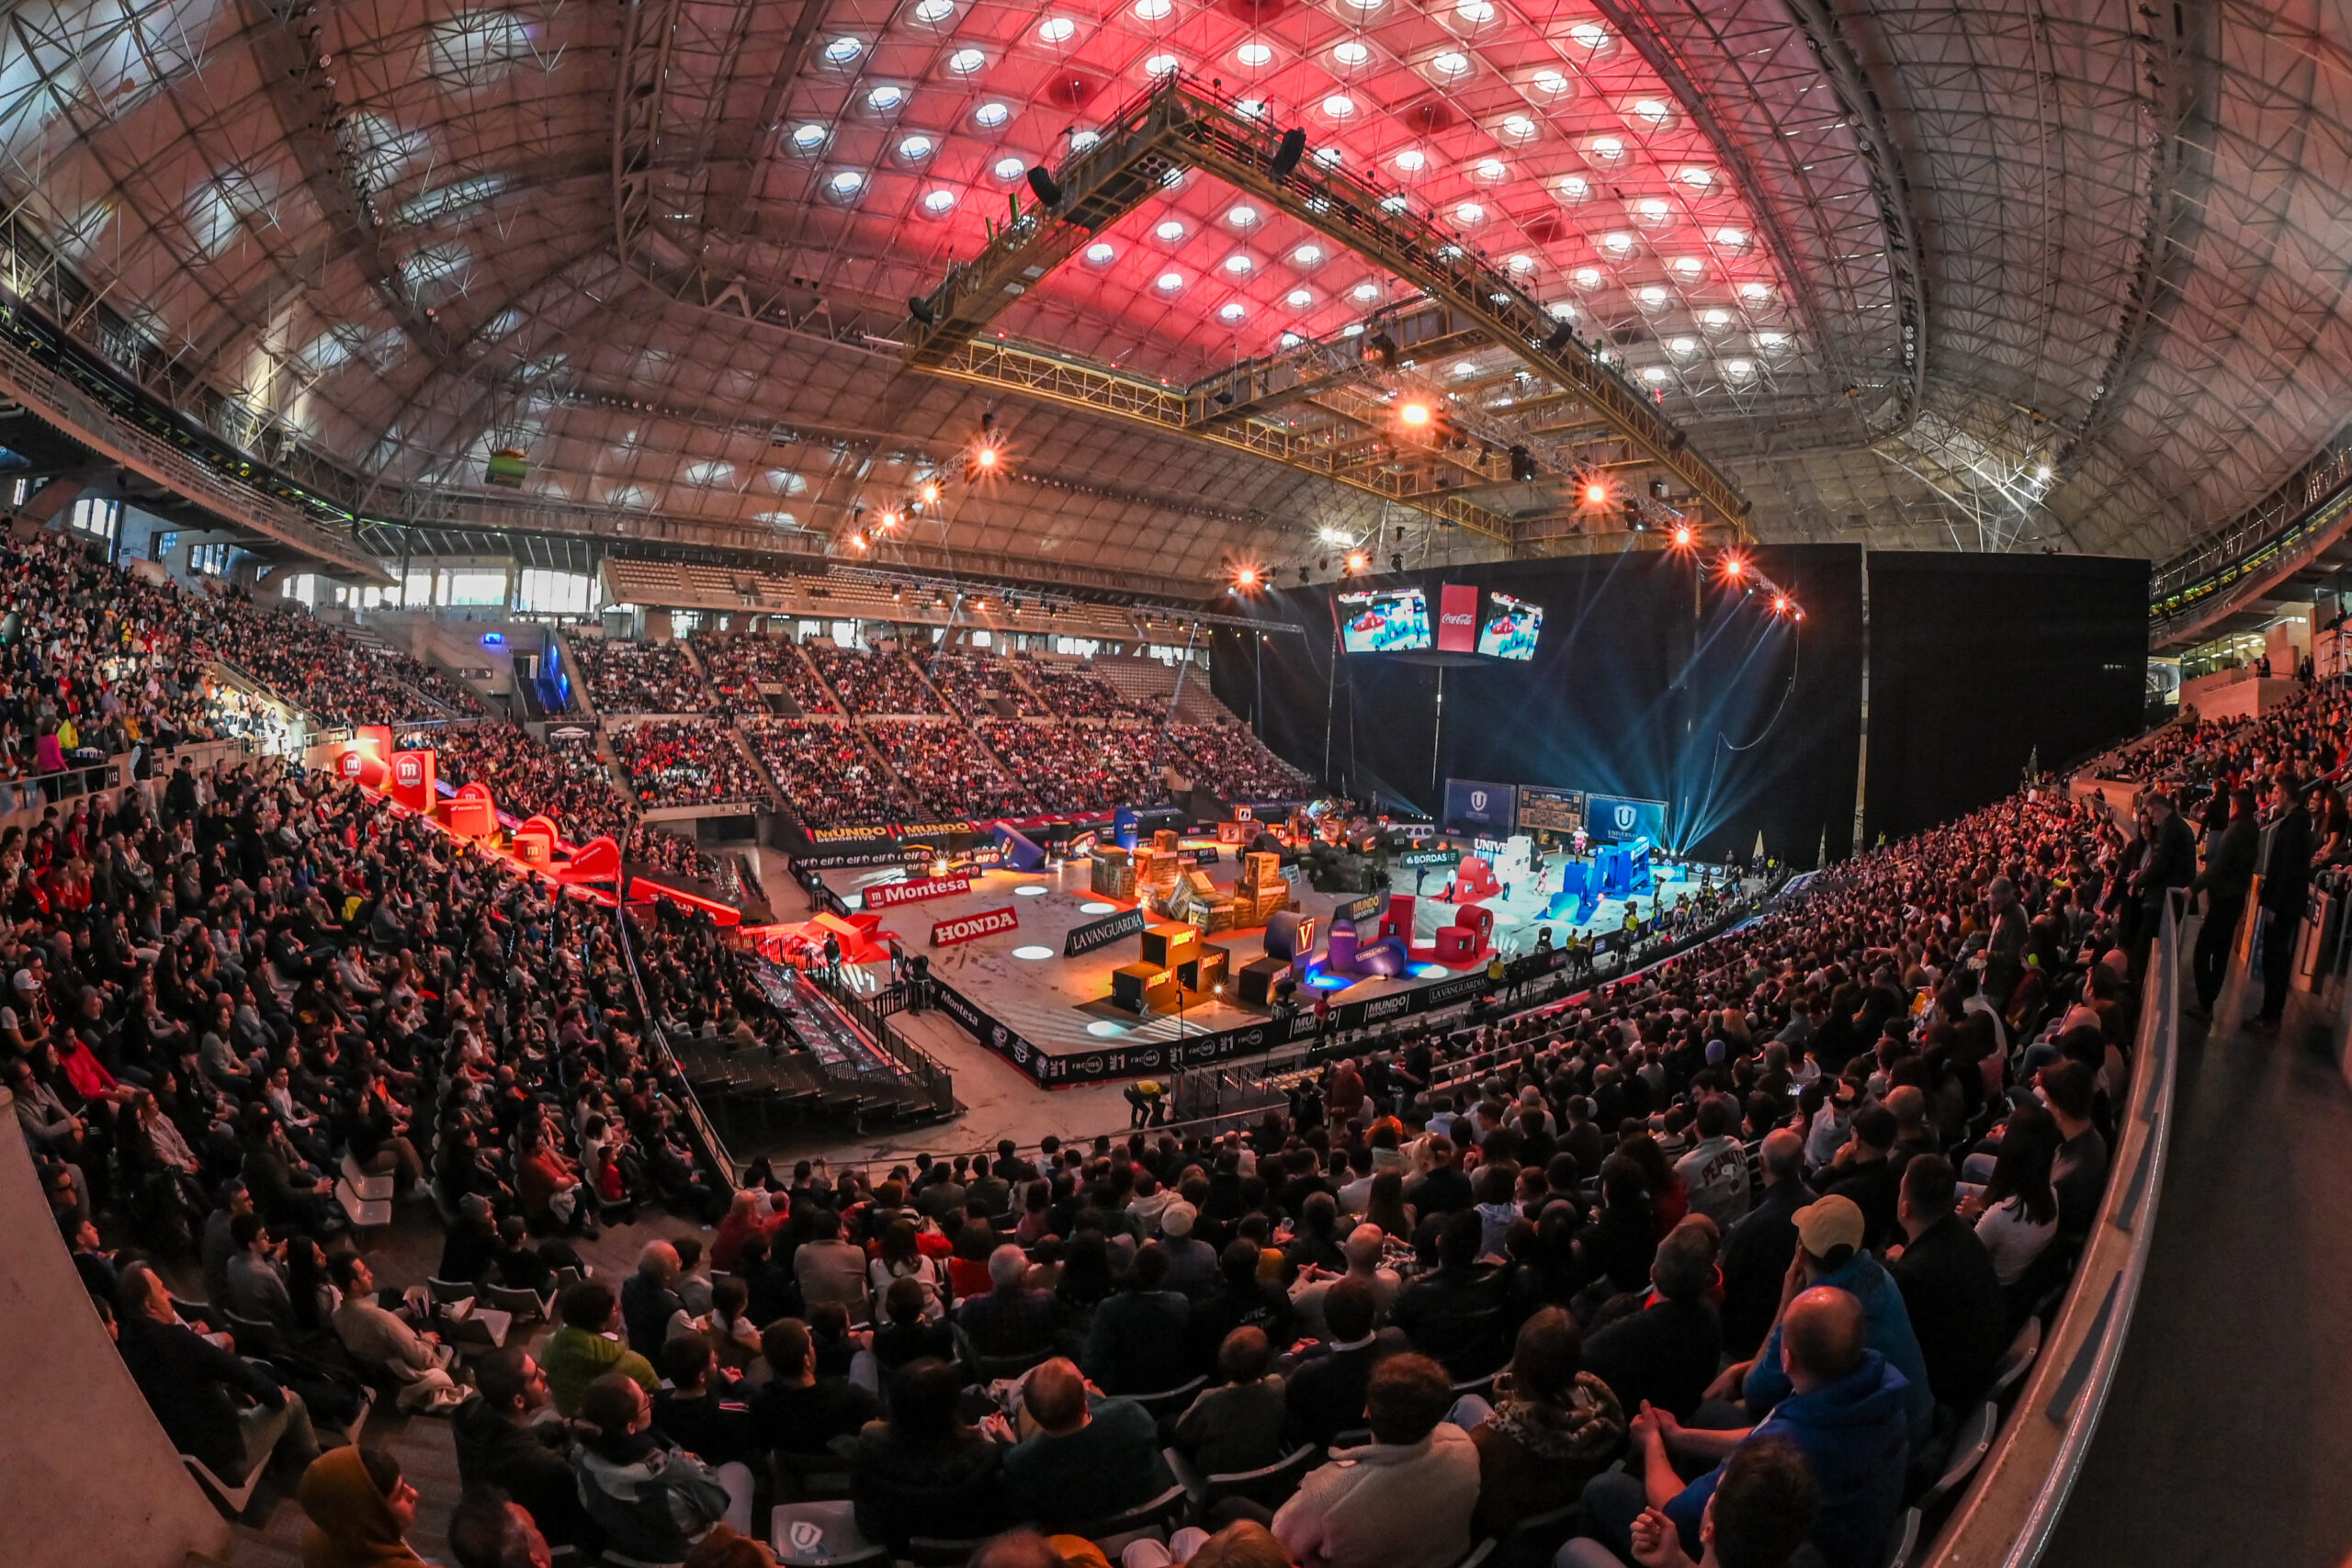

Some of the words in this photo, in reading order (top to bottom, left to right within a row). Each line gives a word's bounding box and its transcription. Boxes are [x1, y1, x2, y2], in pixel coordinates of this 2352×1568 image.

[108, 772, 119, 783] 112
[814, 826, 888, 839] MUNDO
[905, 822, 970, 834] MUNDO
[817, 835, 876, 843] DEPORTIVO
[820, 856, 835, 866] elf
[847, 856, 862, 865] elf
[872, 854, 888, 863] elf
[904, 852, 920, 861] elf
[976, 852, 991, 863] elf
[1414, 853, 1447, 864] BORDAS
[884, 878, 968, 902] Montesa
[1352, 895, 1379, 913] MUNDO
[935, 912, 1015, 942] HONDA
[1298, 922, 1313, 949] V
[940, 990, 978, 1027] Montesa
[1368, 996, 1407, 1012] MUNDO
[1295, 1010, 1337, 1029] MUO
